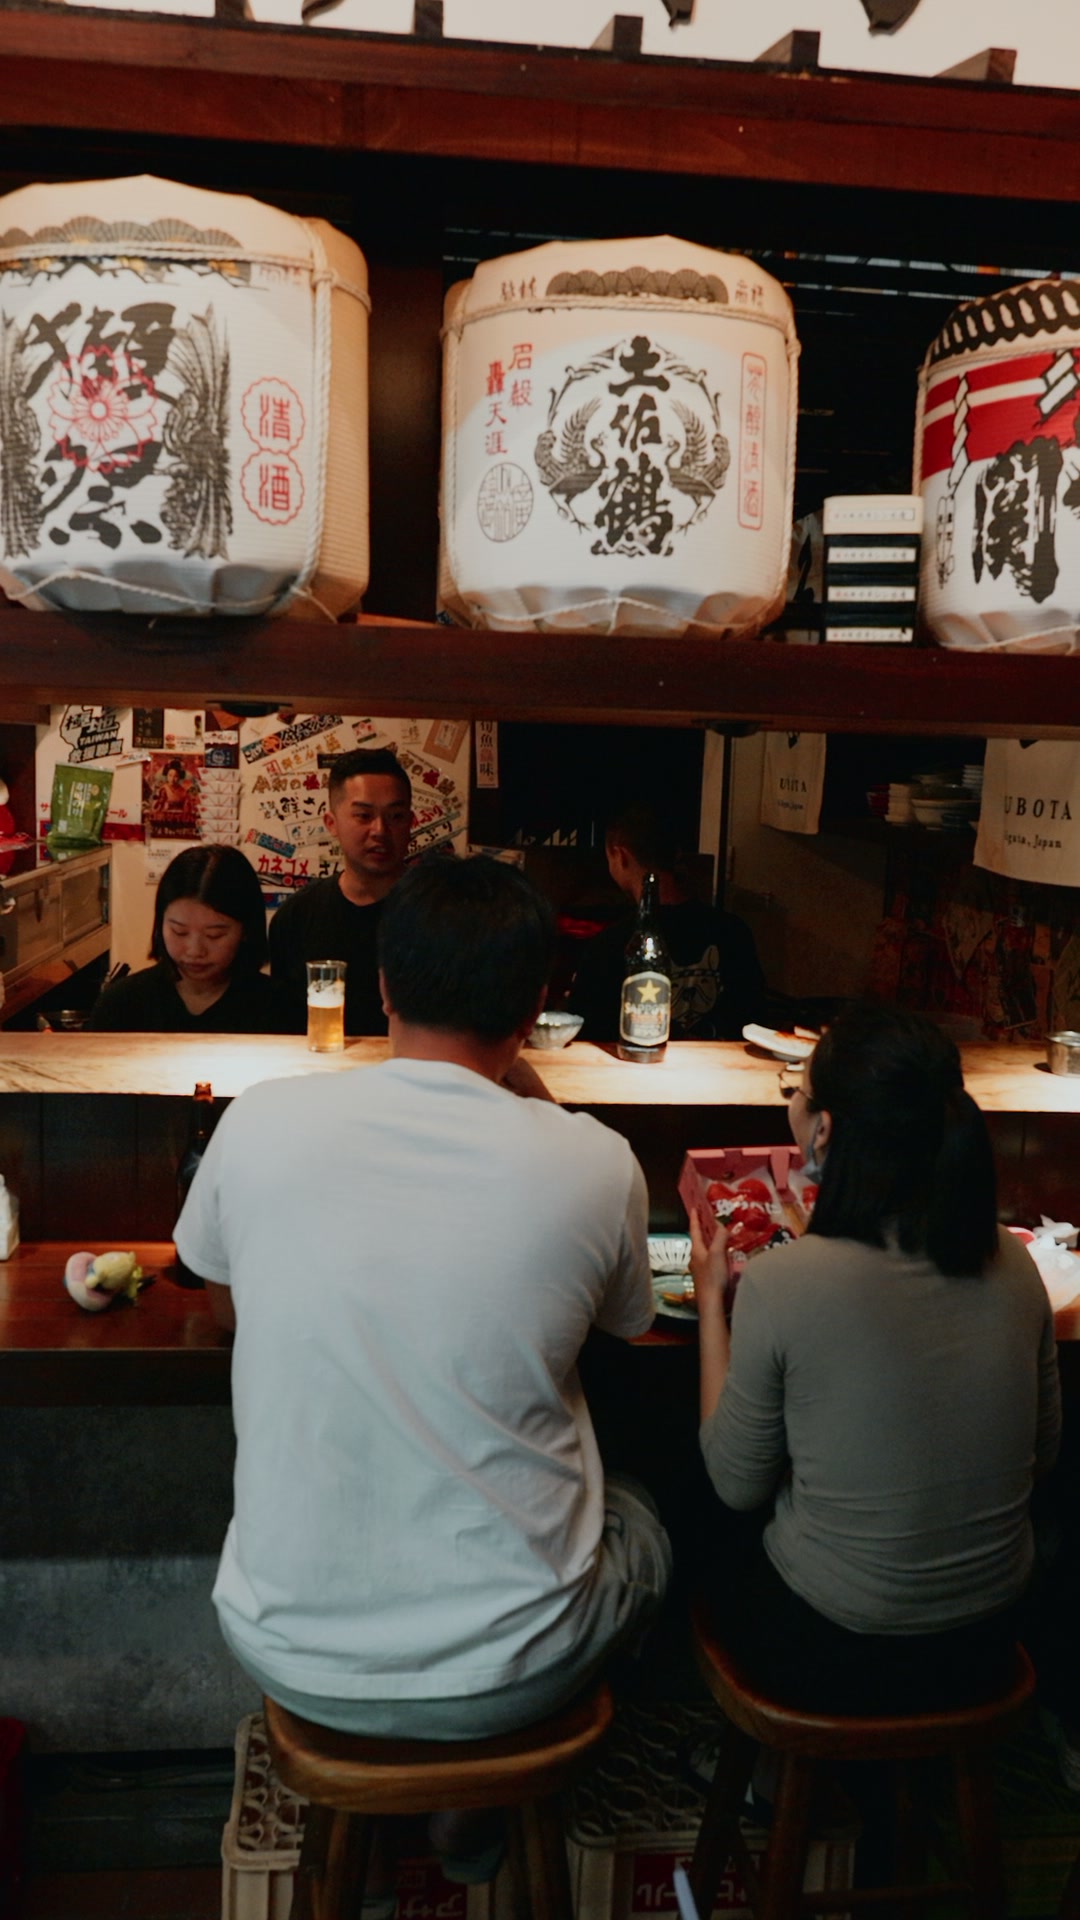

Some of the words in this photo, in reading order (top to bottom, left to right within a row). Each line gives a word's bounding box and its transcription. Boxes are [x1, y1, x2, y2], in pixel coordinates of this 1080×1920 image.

[258, 393, 291, 512] 清酒
[590, 335, 674, 557] 土佐鶴
[79, 730, 117, 747] TAIWAN
[1033, 834, 1062, 851] Japan
[258, 854, 309, 876] カネコメ
